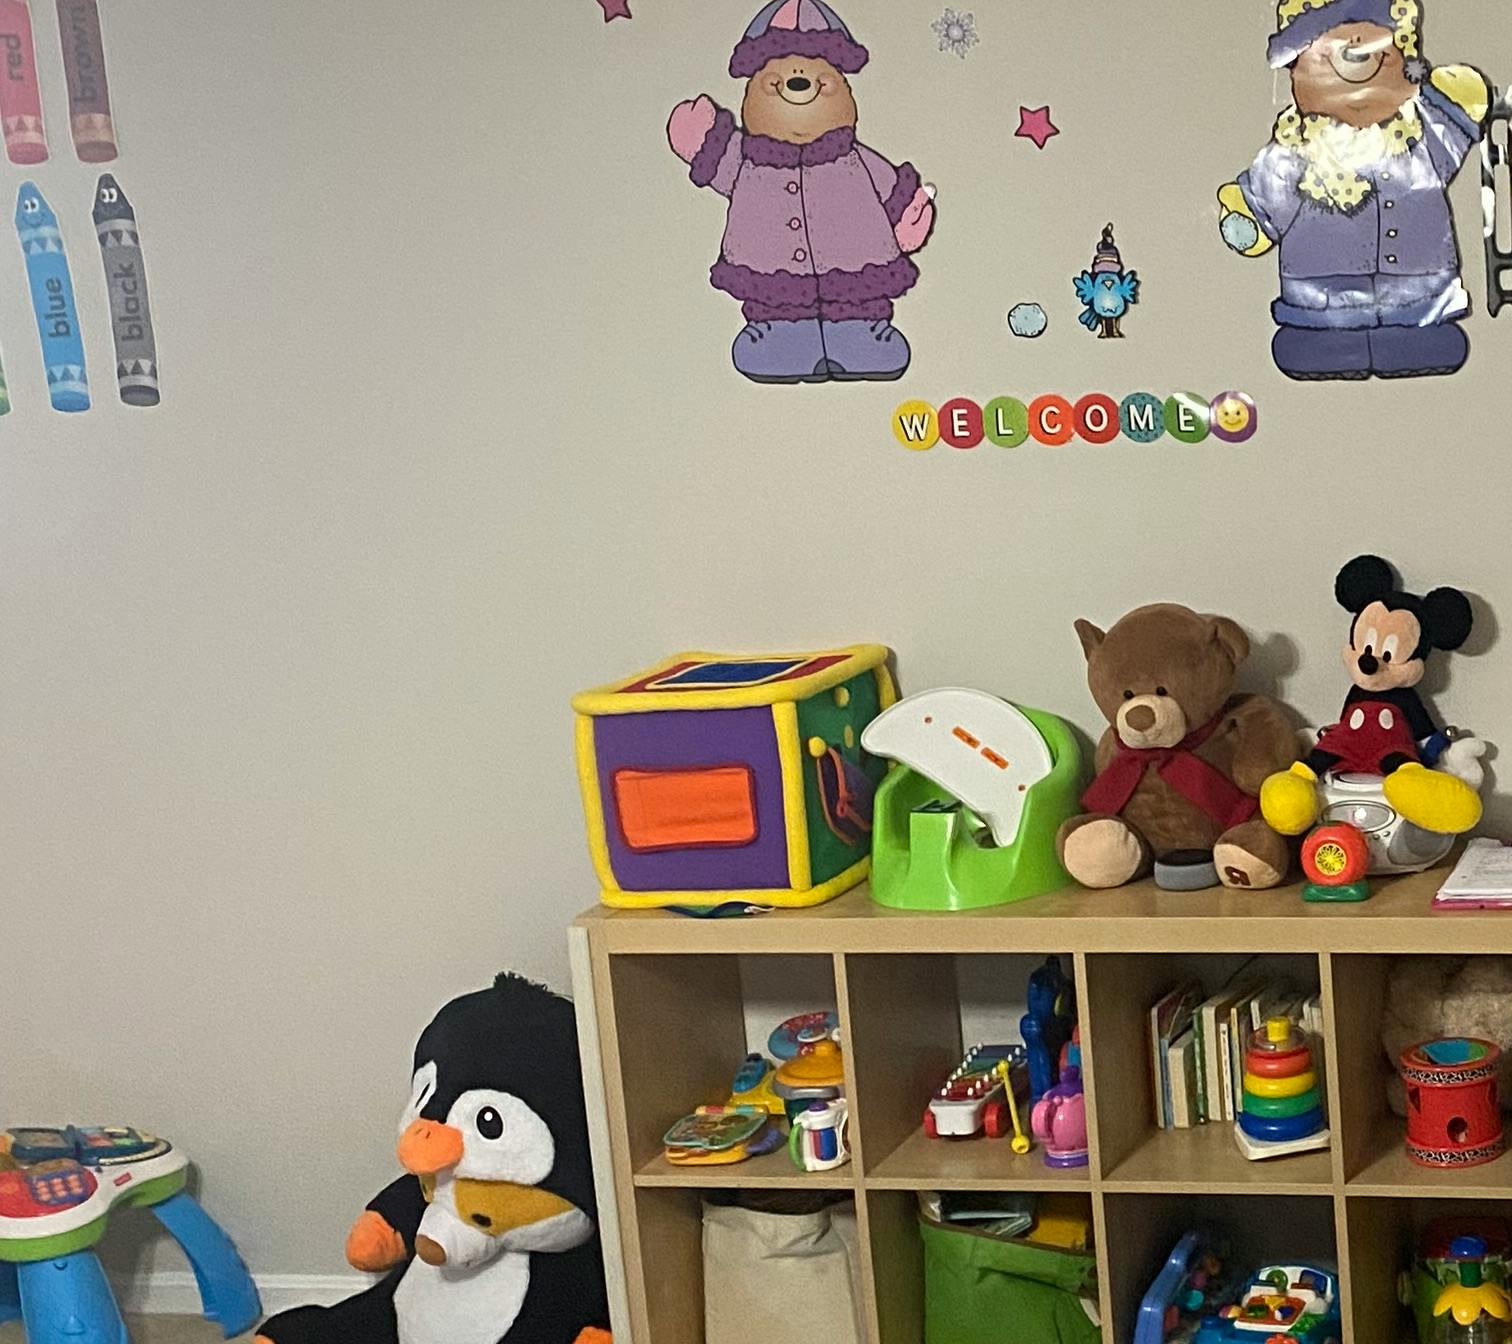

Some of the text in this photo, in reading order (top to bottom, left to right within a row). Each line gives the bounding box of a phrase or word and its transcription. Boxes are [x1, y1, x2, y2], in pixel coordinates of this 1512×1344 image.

[0, 33, 23, 81] red
[74, 5, 98, 105] brown
[45, 276, 71, 339] blue
[114, 260, 144, 343] black
[899, 402, 1196, 441] WELCOME
